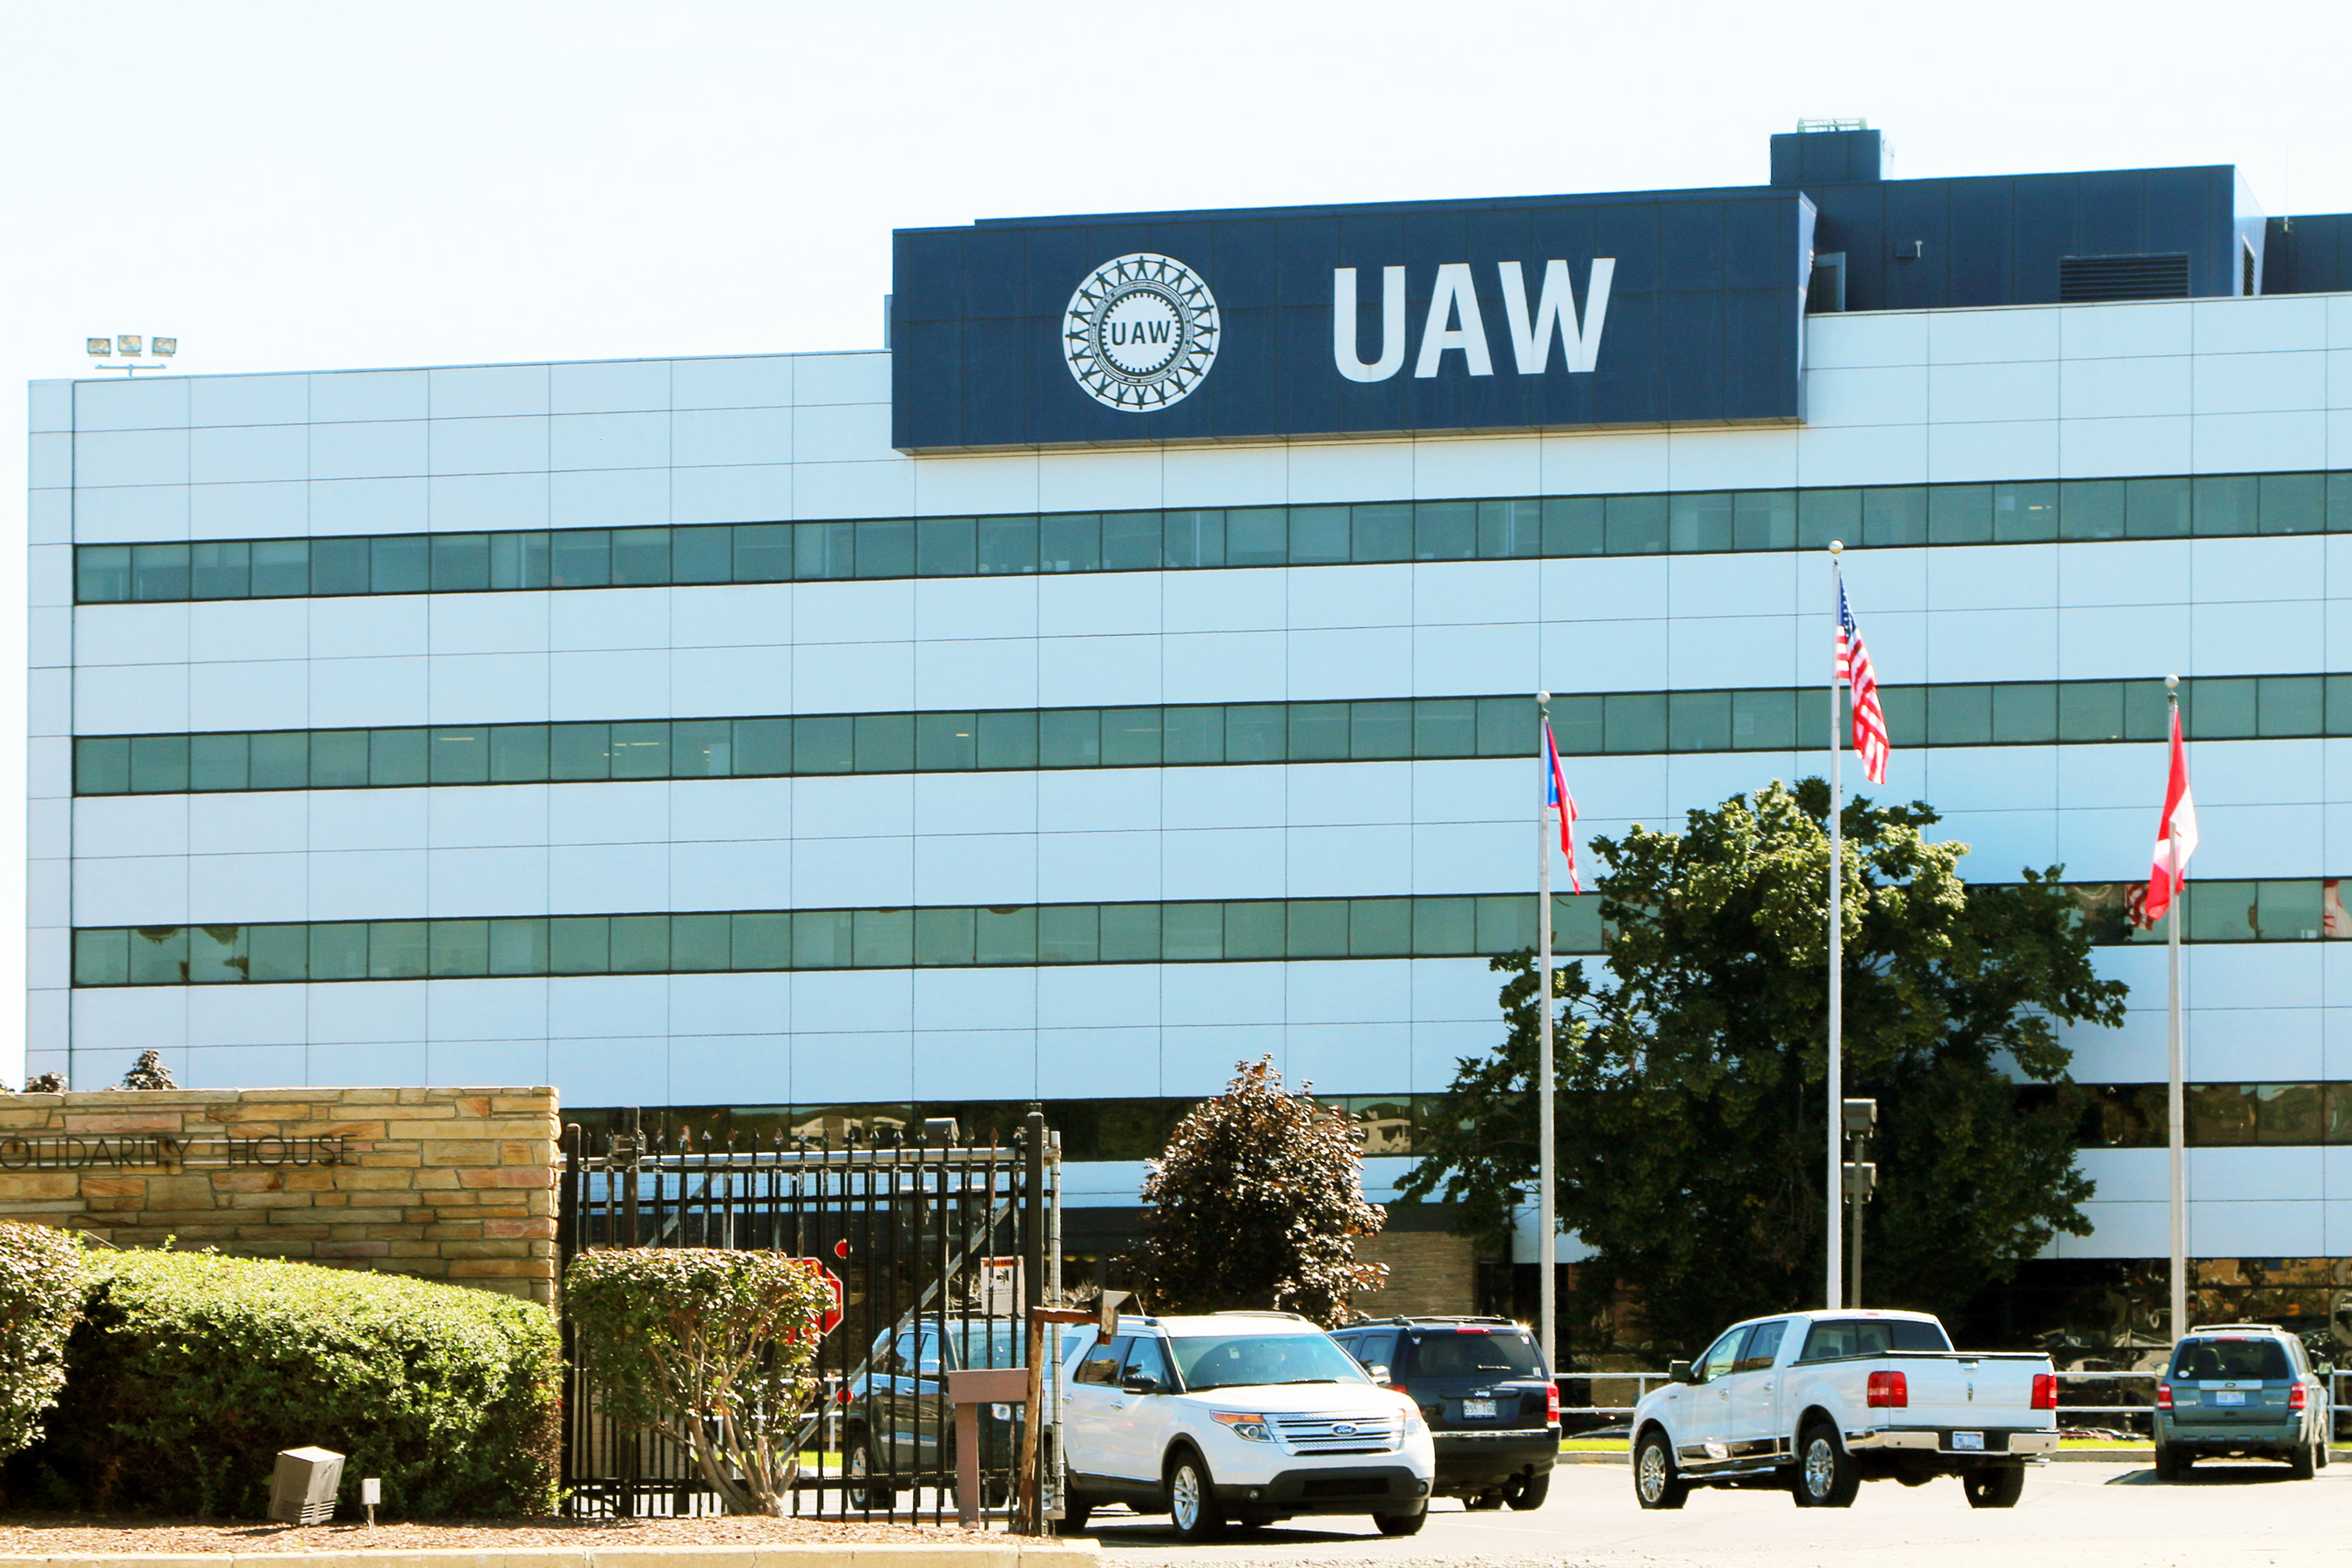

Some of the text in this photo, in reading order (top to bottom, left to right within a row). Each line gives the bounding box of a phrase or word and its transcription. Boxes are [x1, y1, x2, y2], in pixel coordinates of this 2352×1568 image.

[1112, 321, 1171, 346] UAW
[1334, 258, 1616, 382] UAW
[228, 1134, 358, 1167] HOUSE
